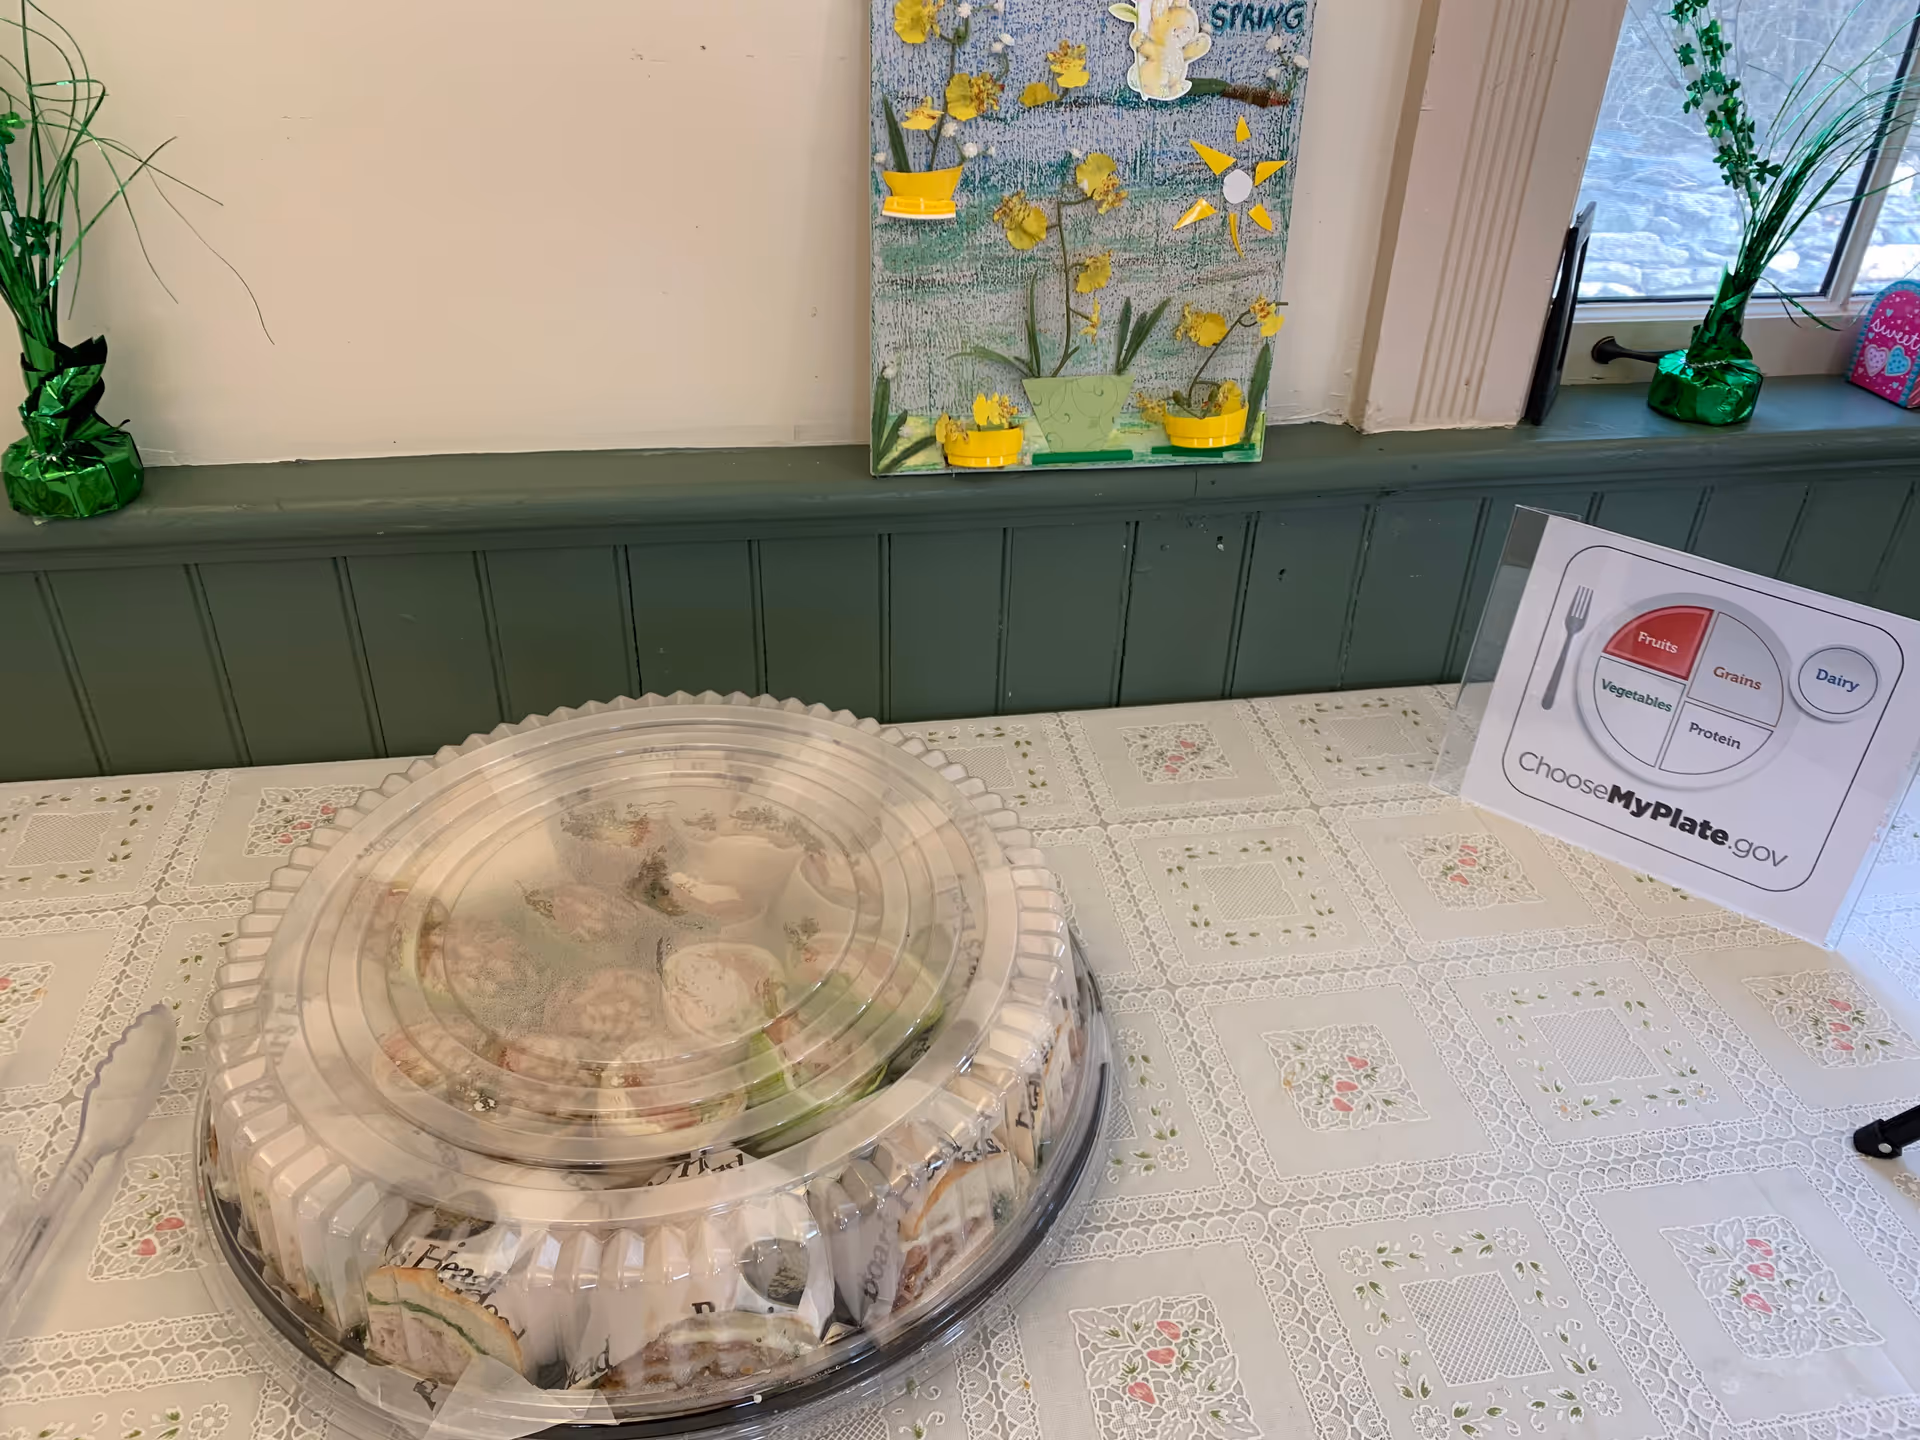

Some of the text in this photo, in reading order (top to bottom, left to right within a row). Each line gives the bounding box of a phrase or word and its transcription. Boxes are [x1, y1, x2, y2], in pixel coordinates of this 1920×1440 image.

[1210, 1, 1308, 33] SPRING
[1637, 631, 1679, 655] Fruits
[1713, 666, 1763, 691] Grains
[1815, 668, 1860, 693] Dairy
[1601, 678, 1673, 713] Vegetables
[1688, 722, 1742, 751] Protein
